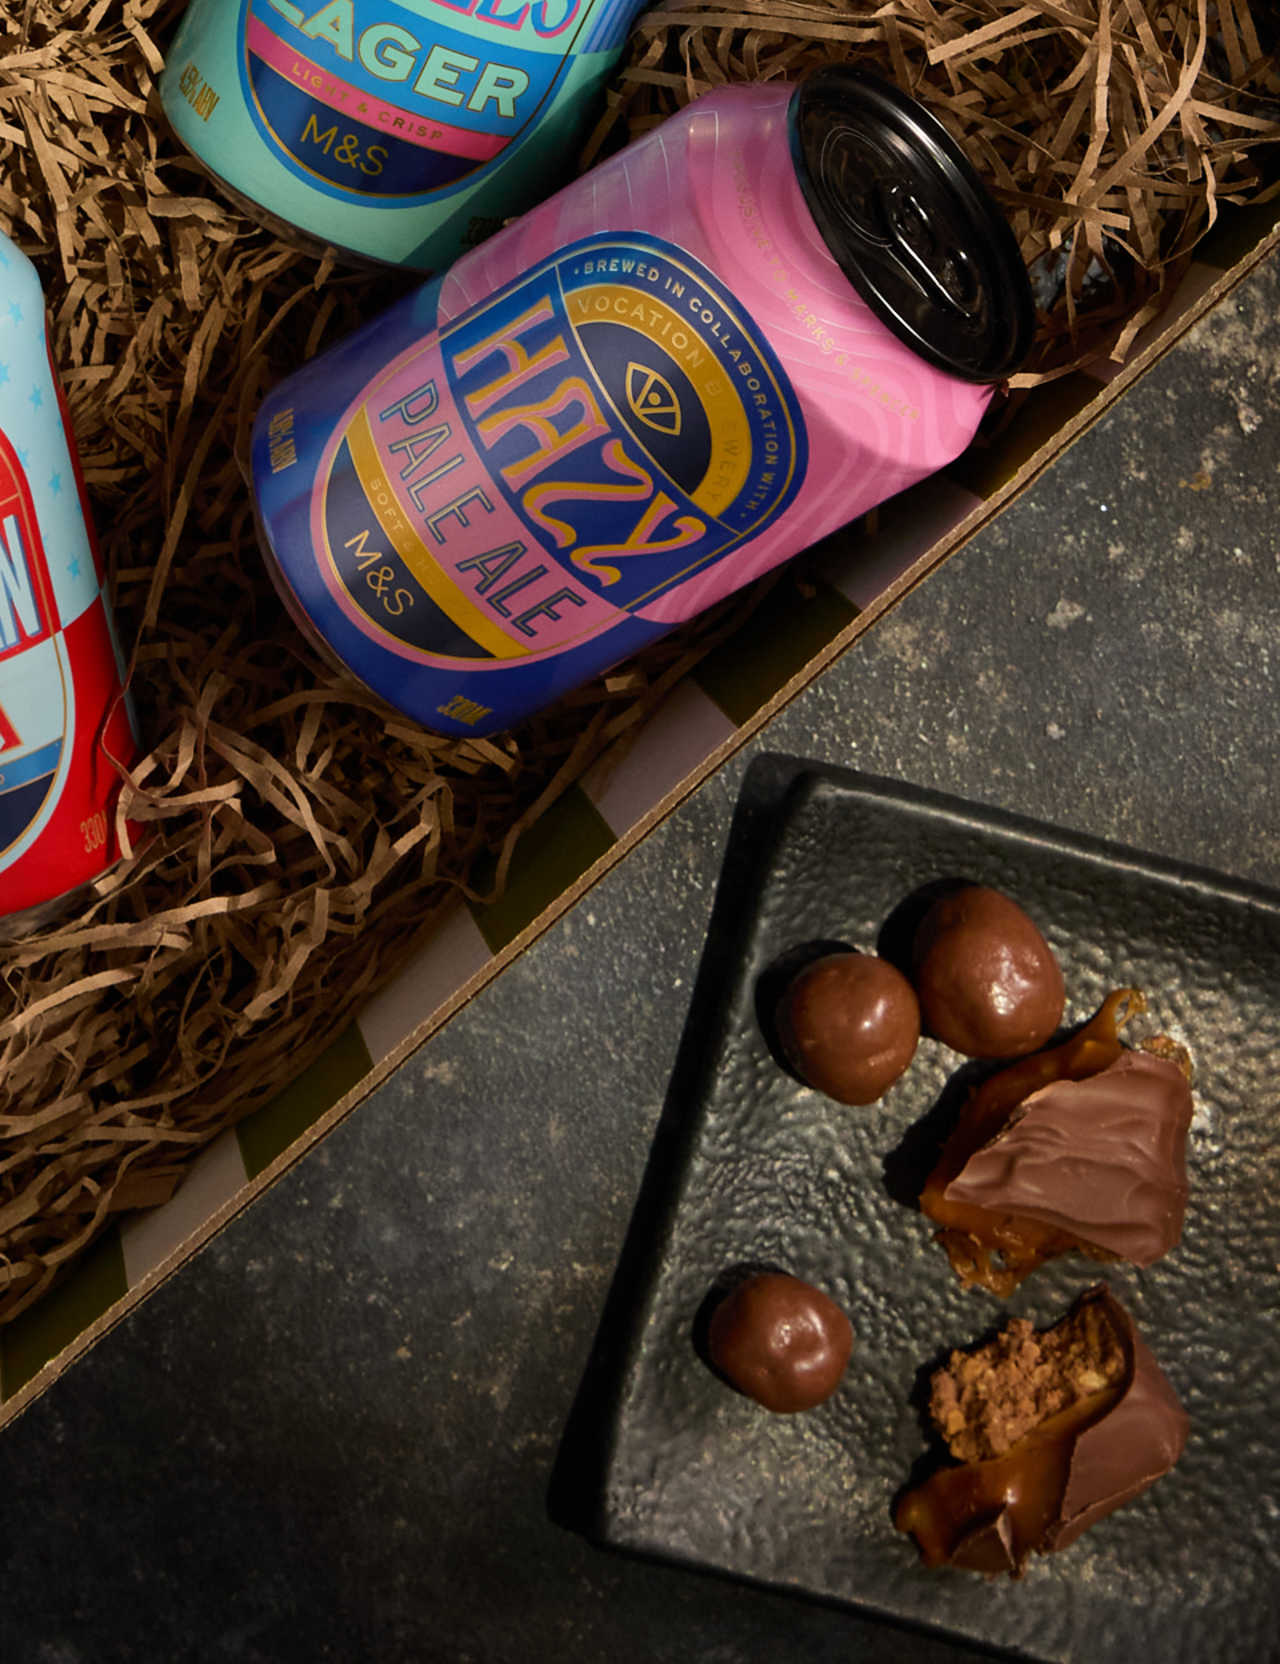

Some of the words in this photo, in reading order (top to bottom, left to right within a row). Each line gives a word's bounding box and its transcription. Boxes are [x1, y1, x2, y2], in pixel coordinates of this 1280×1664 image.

[291, 61, 350, 104] LIGHT
[356, 102, 370, 115] &
[377, 111, 444, 141] CRISP
[300, 113, 390, 177] M&S
[576, 296, 706, 369] VOCATION
[584, 258, 660, 283] BREWED
[665, 276, 686, 300] IN
[689, 297, 779, 466] COLLABORATION
[747, 472, 776, 512] WITH
[452, 294, 707, 588] HAZY
[369, 477, 405, 532] SOFT
[379, 378, 496, 546] PALE
[455, 539, 588, 638] ALE
[344, 529, 415, 617] M&S
